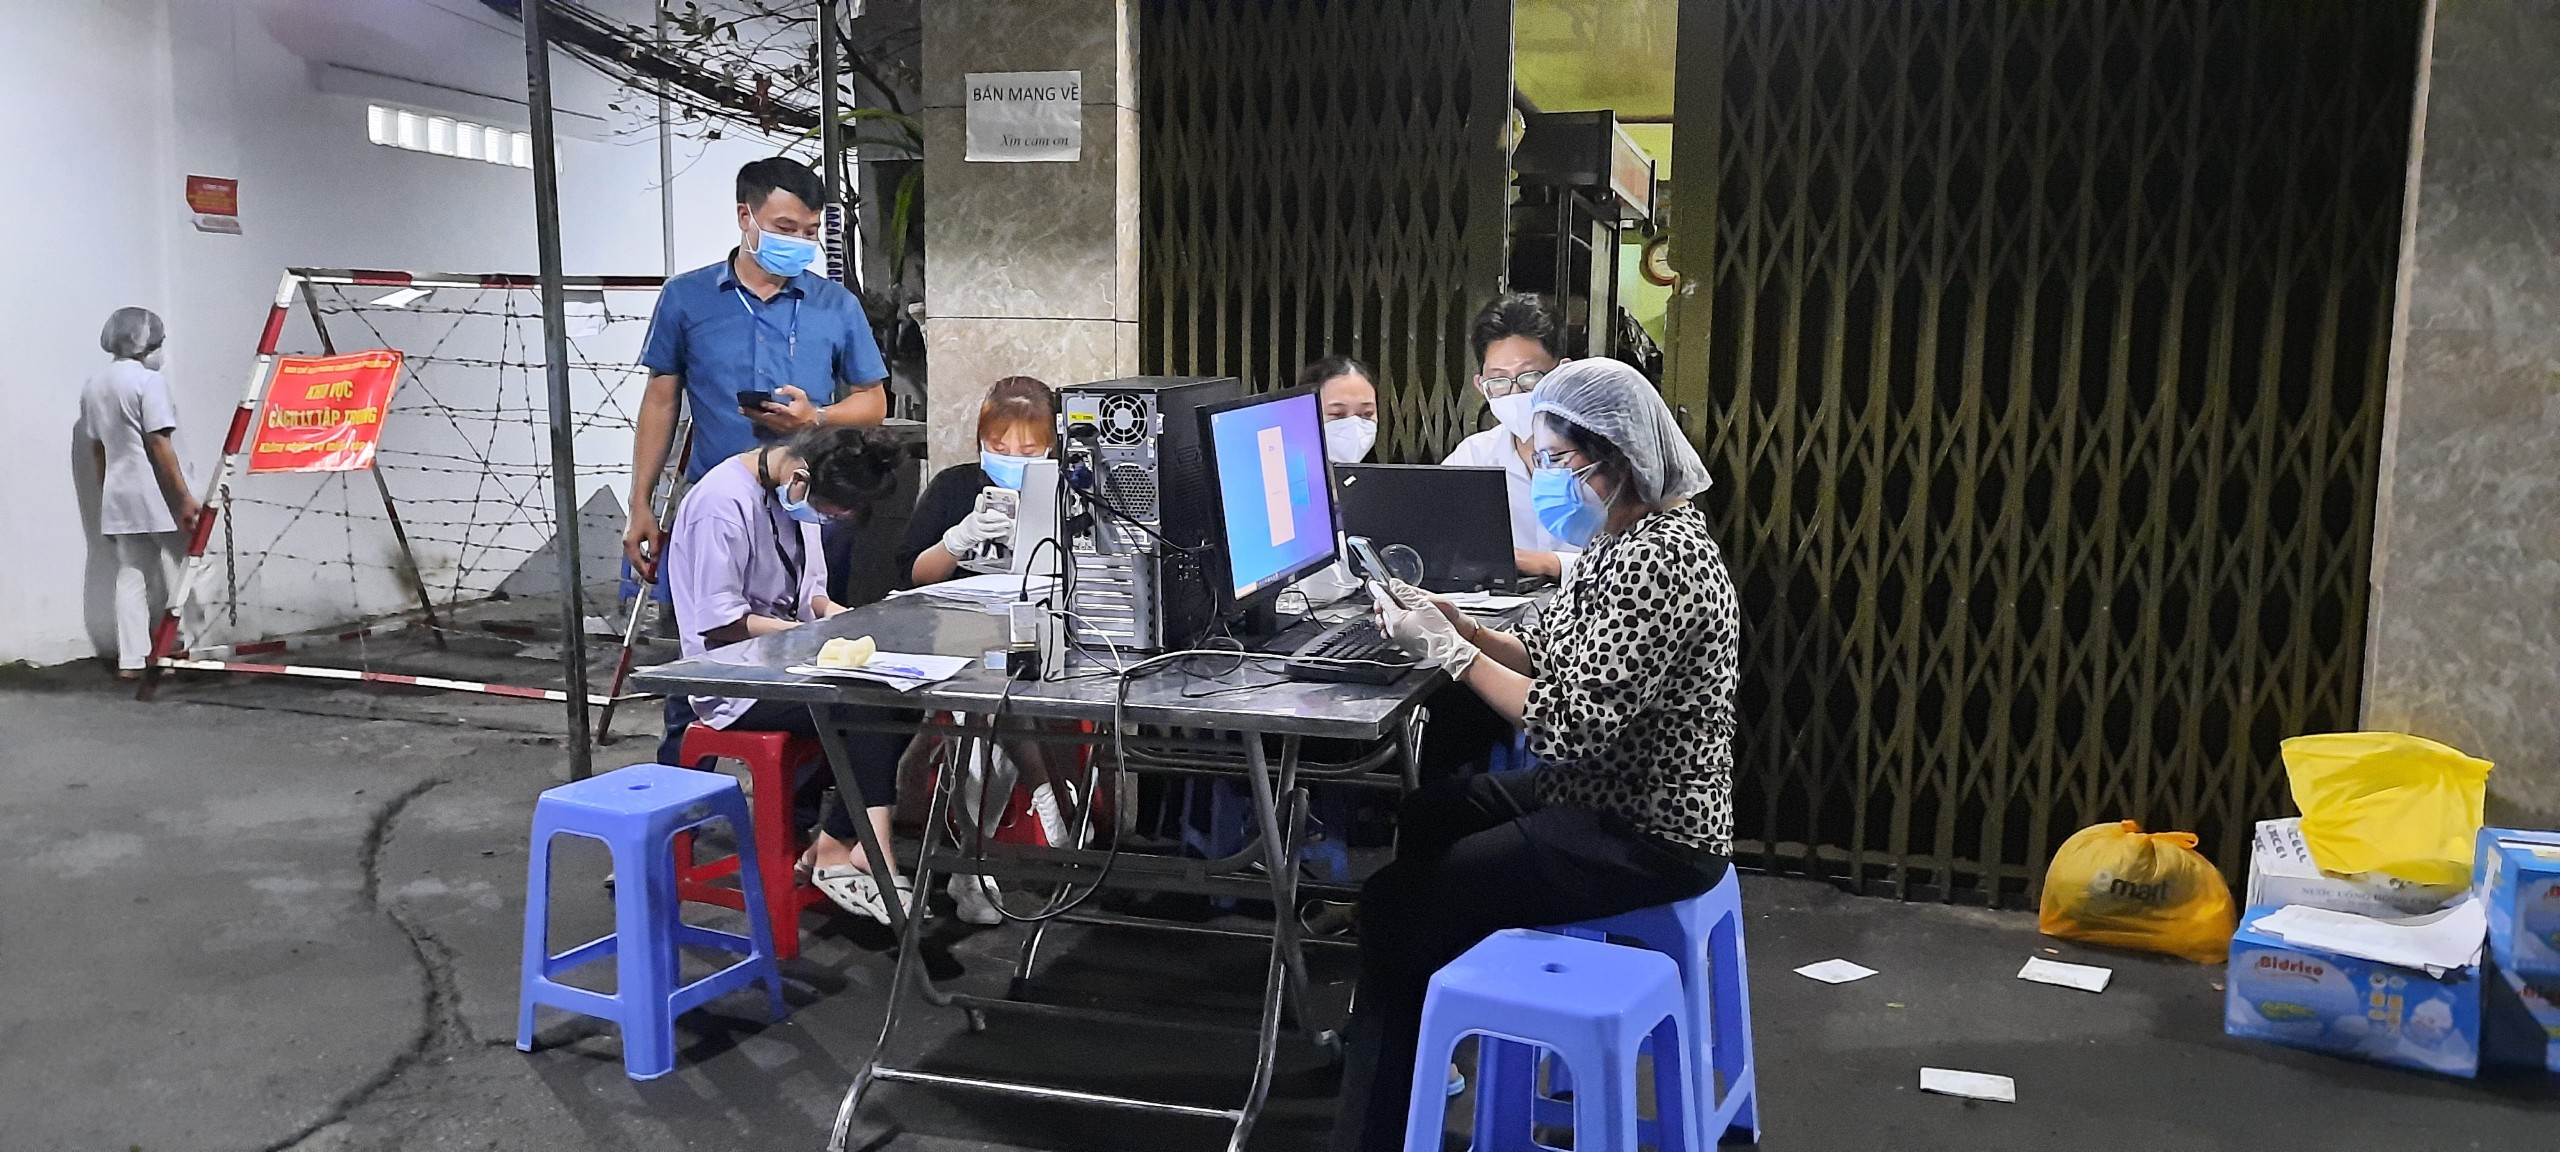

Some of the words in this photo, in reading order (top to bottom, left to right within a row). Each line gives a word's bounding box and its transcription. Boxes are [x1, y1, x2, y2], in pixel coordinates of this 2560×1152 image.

[973, 84, 1004, 101] BÁN
[1008, 87, 1056, 101] MANG
[1000, 134, 1021, 147] Xin
[305, 383, 331, 400] KHU
[2259, 955, 2325, 977] Bidrico
